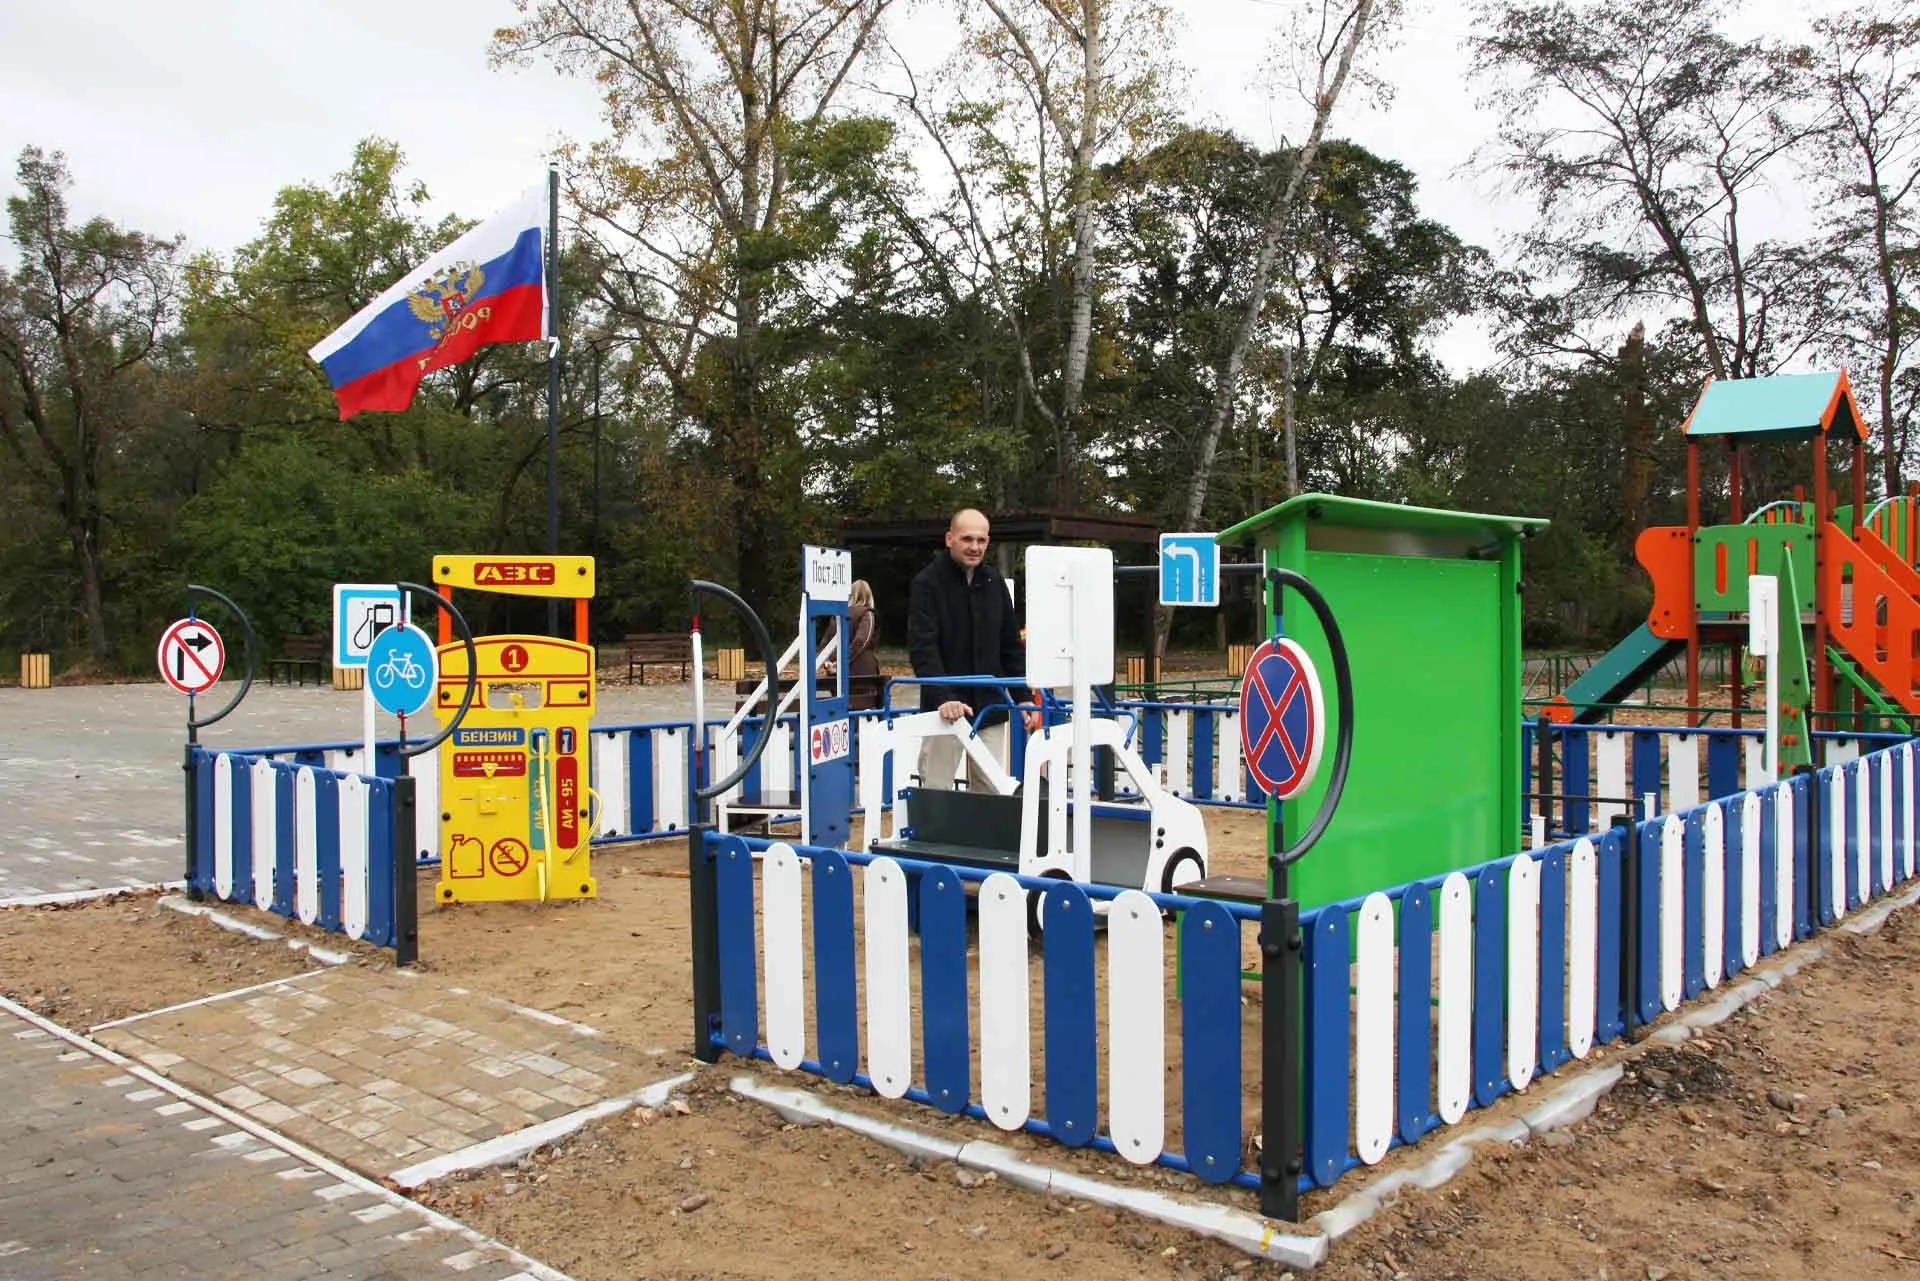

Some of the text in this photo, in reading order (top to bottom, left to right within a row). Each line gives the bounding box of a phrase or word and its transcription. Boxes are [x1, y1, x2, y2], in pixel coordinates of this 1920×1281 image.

[812, 559, 831, 585] Пост
[508, 649, 521, 669] 1
[461, 731, 517, 743] БЕНЗИН
